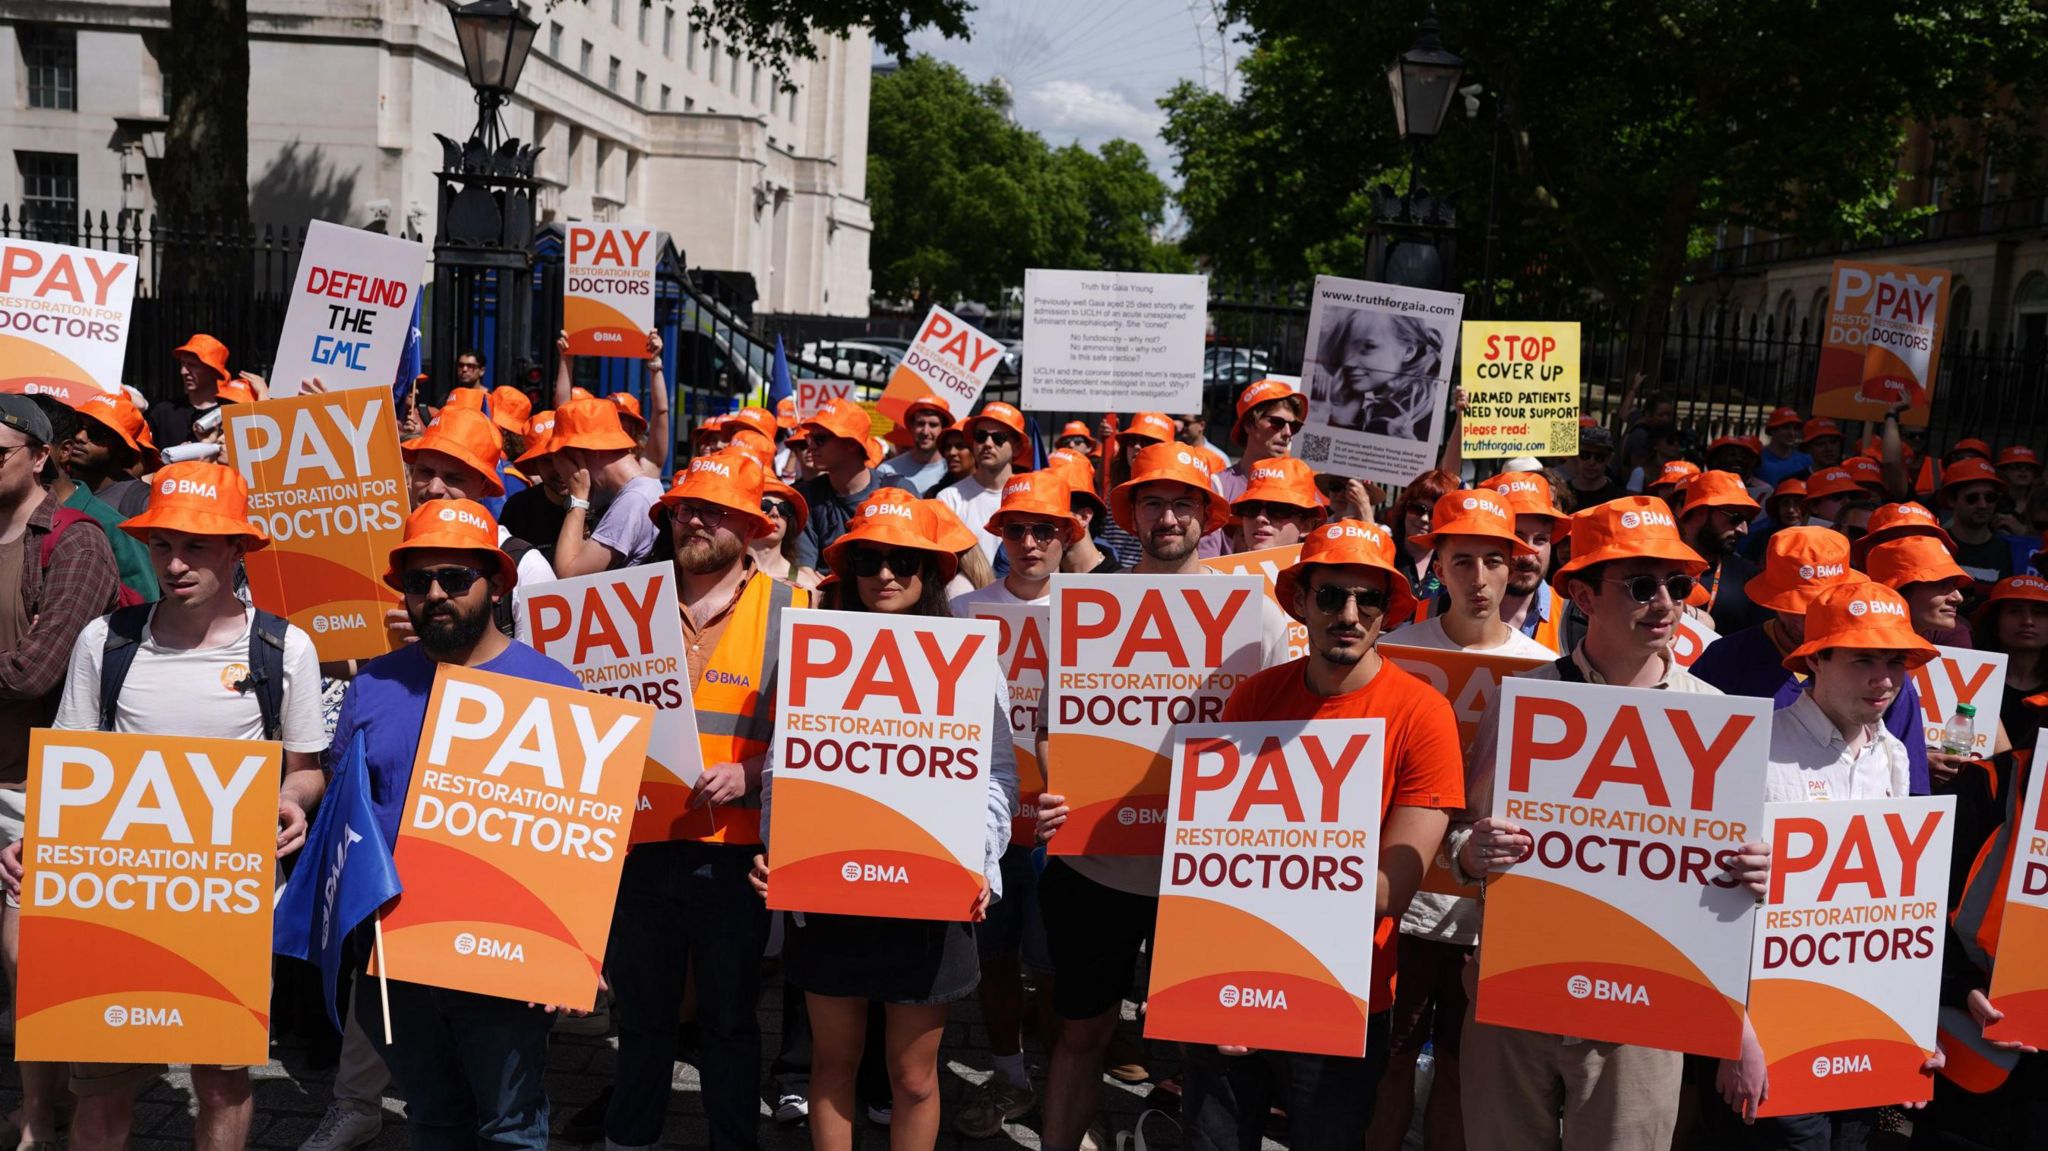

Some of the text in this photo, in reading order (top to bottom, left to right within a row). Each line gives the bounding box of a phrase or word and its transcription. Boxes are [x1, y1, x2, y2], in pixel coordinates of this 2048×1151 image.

[569, 228, 650, 267] PAY
[0, 246, 128, 306] PAY
[569, 267, 650, 278] RESTORATION FOR
[307, 266, 408, 309] DEFUND
[569, 278, 650, 295] DOCTORS
[96, 308, 123, 321] FOR
[1321, 289, 1455, 316] www.truthforgaia.com
[1875, 282, 1934, 326] PAY
[329, 304, 377, 335] THE
[603, 333, 622, 342] BMA
[920, 312, 999, 373] PAY
[1872, 327, 1928, 351] DOCTORS
[311, 335, 371, 372] GMC
[907, 352, 977, 399] DOCTORS
[1477, 362, 1564, 382] COVER UP
[800, 383, 850, 409] PAY
[1518, 392, 1571, 404] PATIENTS
[1463, 406, 1579, 419] NEED YOUR SUPPORT
[1463, 423, 1530, 437] please read:
[231, 399, 383, 490] PAY
[1463, 440, 1546, 454] truthforgaia.com
[701, 462, 731, 478] BMA
[1258, 468, 1285, 480] BMA
[178, 480, 218, 500] BMA
[247, 479, 398, 510] RESTORATION FOR
[1008, 481, 1031, 494] BMA
[1511, 481, 1540, 494] BMA
[249, 500, 403, 542] DOCTORS
[458, 511, 490, 533] BMA
[879, 503, 913, 520] BMA
[1479, 499, 1507, 520] BMA
[1639, 511, 1674, 530] BMA
[1346, 527, 1381, 547] BMA
[1817, 563, 1844, 578] BMA
[331, 613, 367, 631] BMA
[527, 575, 664, 666] PAY
[1869, 601, 1905, 617] BMA
[1060, 588, 1251, 668] PAY
[575, 657, 677, 684] ORATION FOR
[720, 671, 750, 688] BMA
[789, 622, 986, 717] PAY
[1060, 672, 1202, 691] RESTORATION
[1060, 695, 1228, 726] DOCTOR
[427, 678, 641, 796] PAY
[787, 713, 981, 742] RESTORATION FOR
[785, 737, 979, 780] DOCTORS
[1508, 695, 1756, 812] PAY
[1178, 734, 1371, 823] PAY
[1808, 780, 1826, 790] PAY
[38, 744, 267, 846] PAY
[422, 769, 574, 815] RESTORATION
[577, 800, 623, 825] FOR
[413, 794, 617, 864] DOCTORS
[1139, 808, 1167, 825] BM
[1506, 798, 1747, 843] RESTORATION FOR
[1175, 828, 1367, 849] RESTORATION FOR
[36, 844, 263, 873] RESTORATION FOR
[1768, 811, 1945, 905] PAY
[863, 864, 909, 884] BMA
[1171, 852, 1365, 892] DOCTORS
[34, 870, 262, 915] DOCTORS
[1766, 901, 1937, 929] RESTORATION FOR
[477, 937, 526, 963] BMA
[1763, 926, 1935, 969] DOCTORS
[1241, 987, 1288, 1010] BMA
[1594, 978, 1650, 1006] BMA
[130, 1007, 183, 1026] BMA
[1832, 1054, 1872, 1075] BMA
